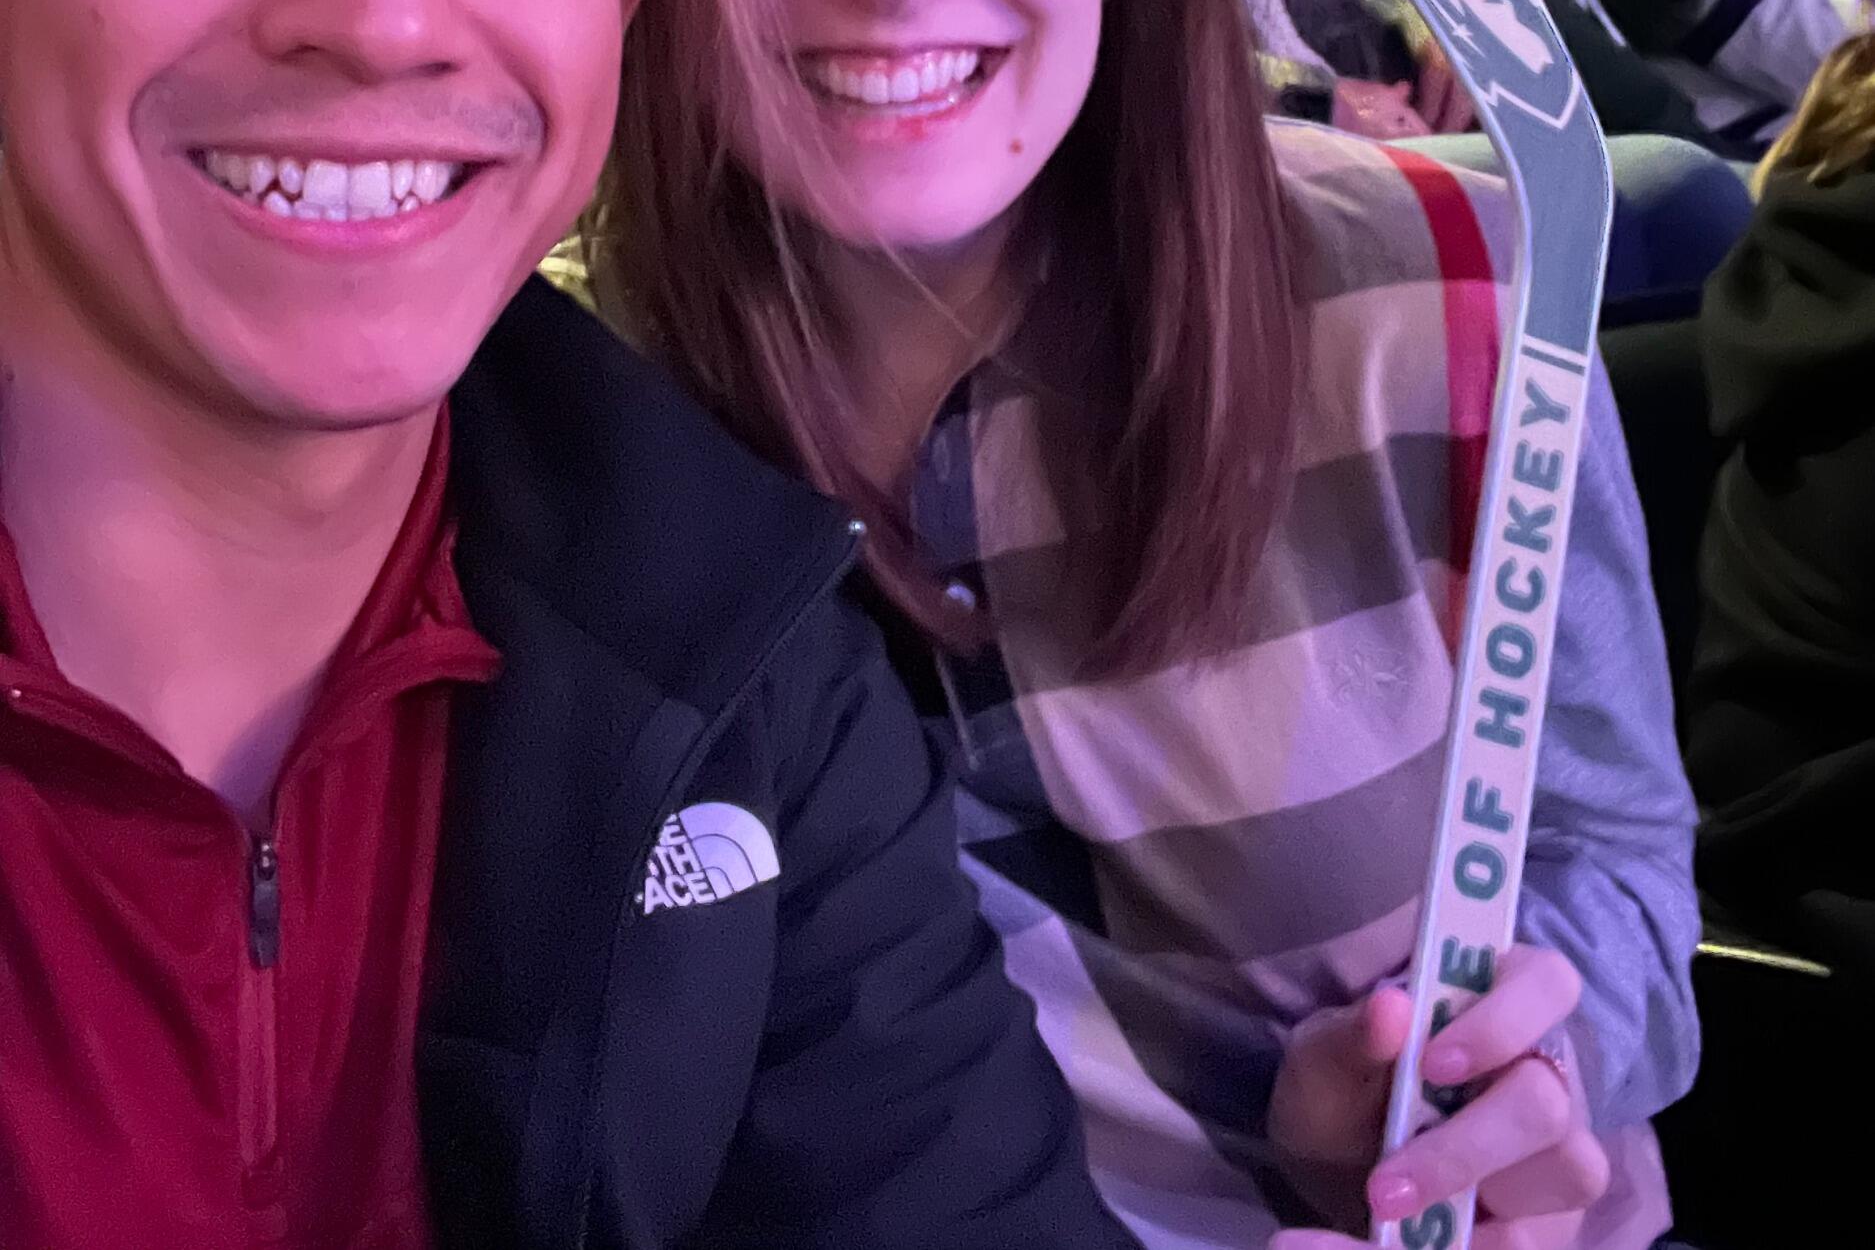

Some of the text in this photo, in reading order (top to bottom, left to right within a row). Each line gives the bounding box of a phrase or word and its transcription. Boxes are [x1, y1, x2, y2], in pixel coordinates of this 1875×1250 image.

[1453, 376, 1571, 901] OF HOCKEY
[634, 871, 718, 916] ACE
